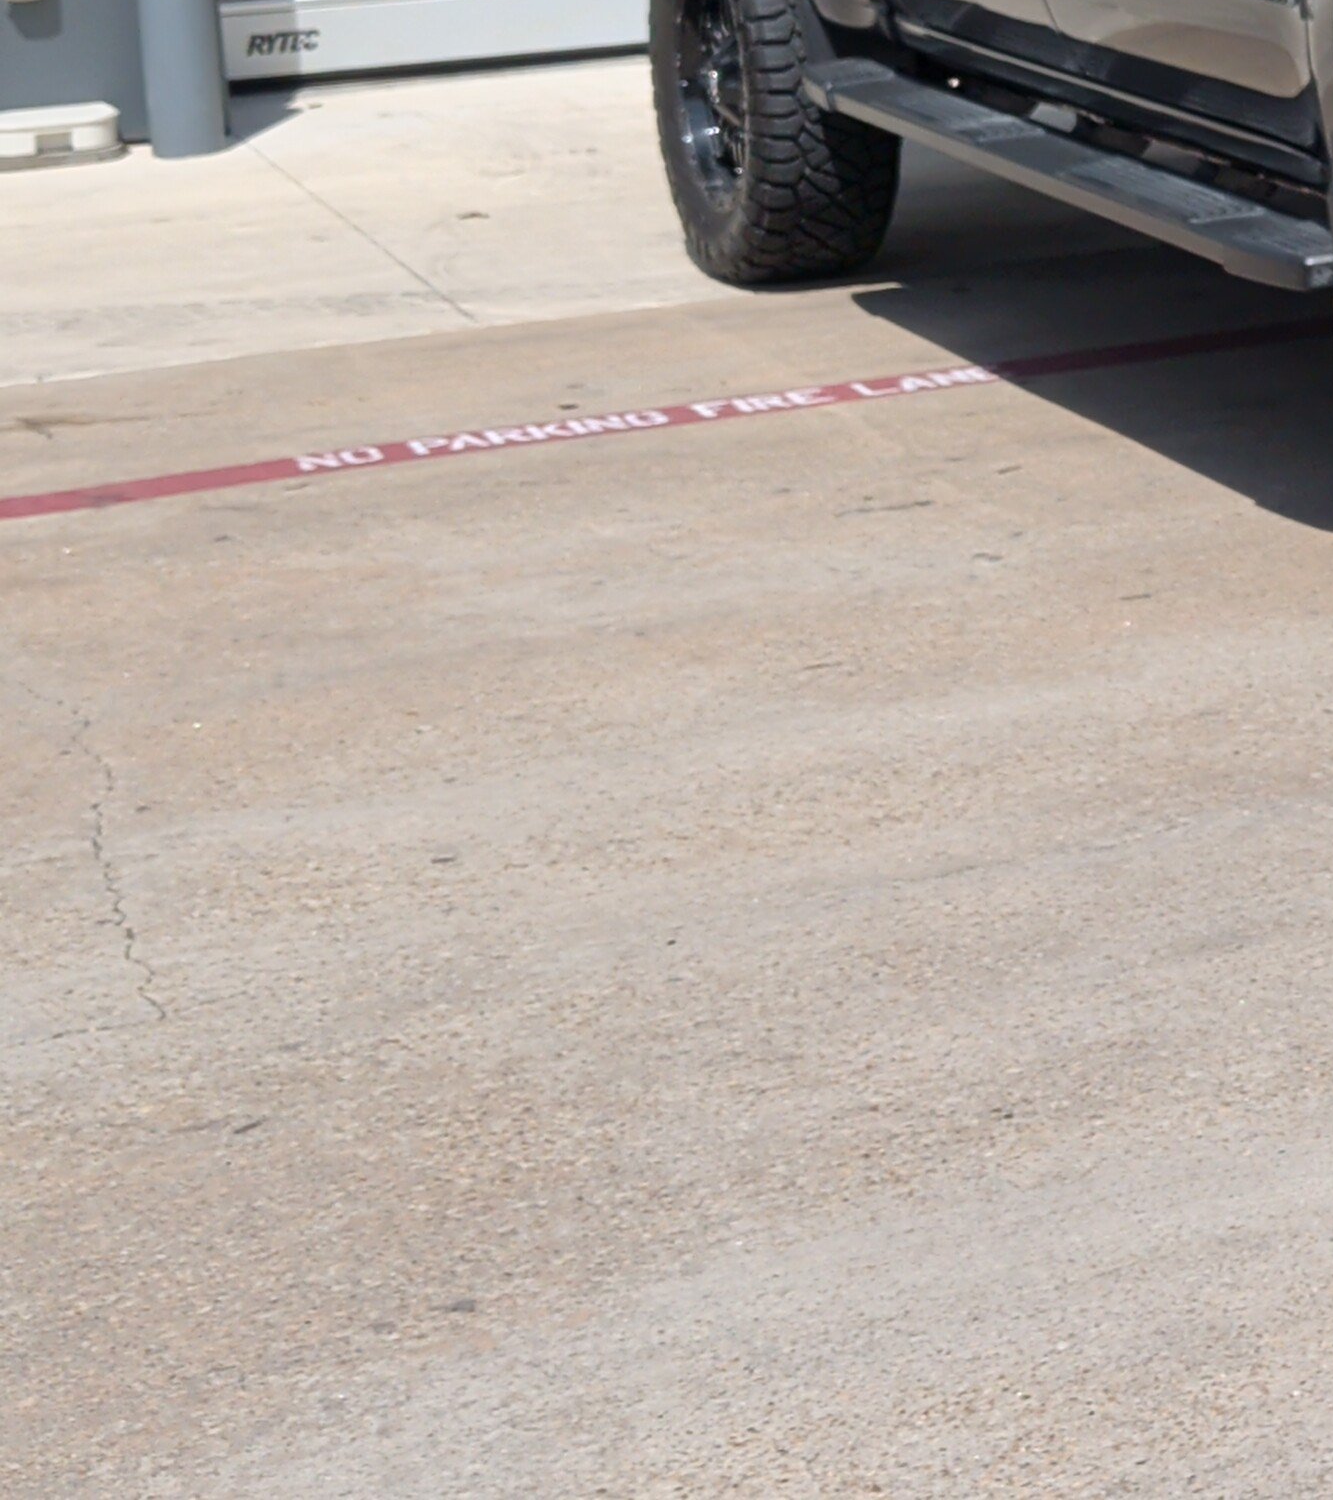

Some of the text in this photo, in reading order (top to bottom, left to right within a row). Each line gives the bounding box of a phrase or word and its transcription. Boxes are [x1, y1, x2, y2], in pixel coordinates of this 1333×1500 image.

[246, 29, 320, 58] RYTEC
[294, 364, 1002, 472] NO PARKING FIRE LANE
